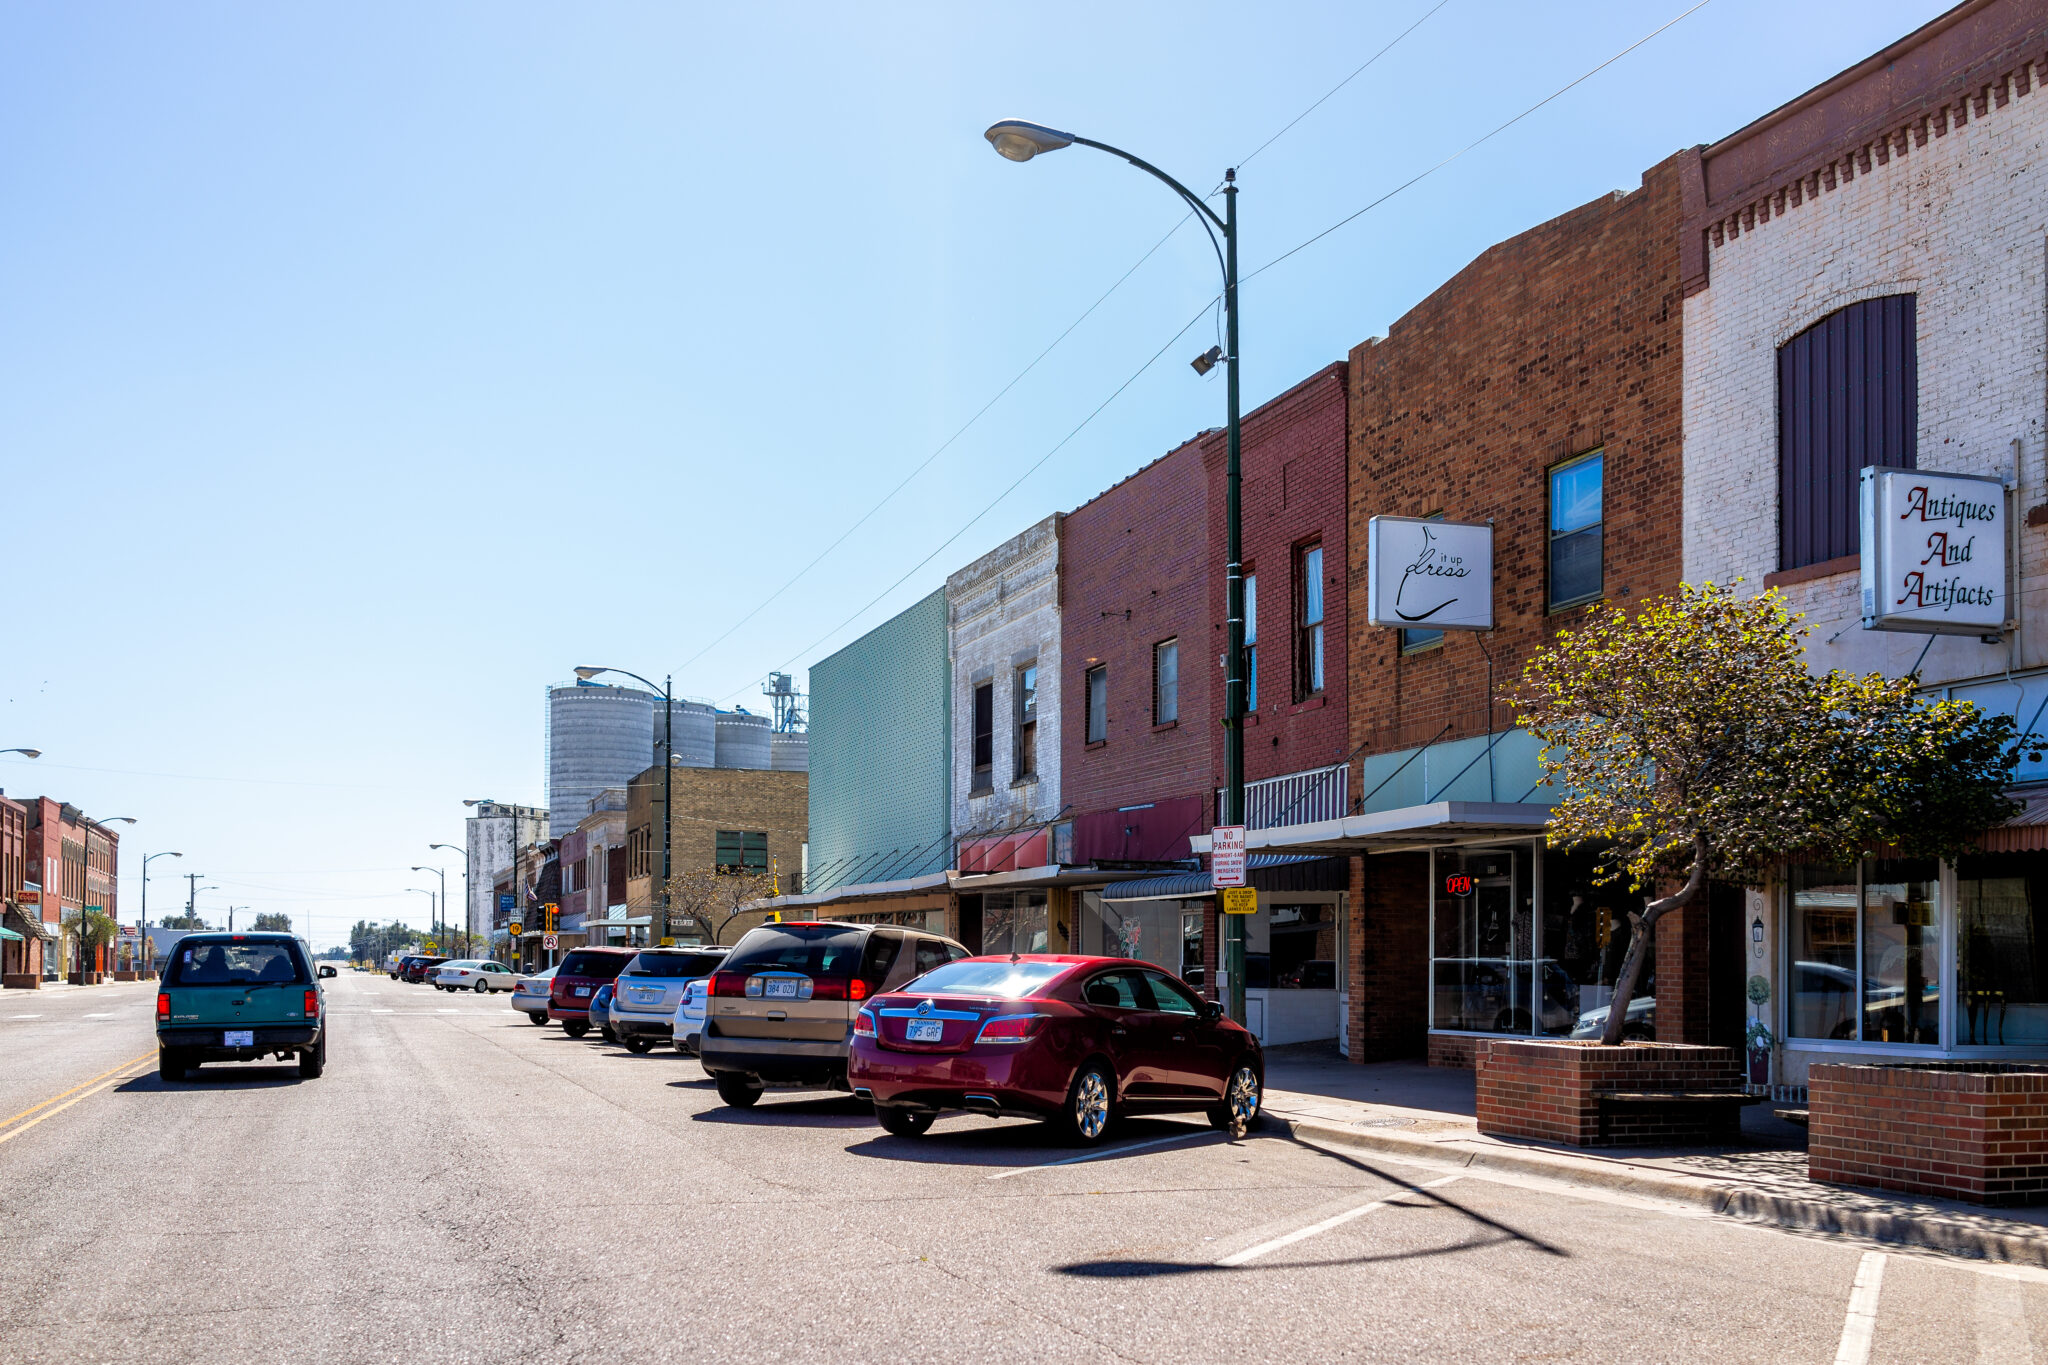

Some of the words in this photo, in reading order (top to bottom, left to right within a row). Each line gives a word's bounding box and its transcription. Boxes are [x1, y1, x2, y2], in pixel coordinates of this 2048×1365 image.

[1900, 486, 1996, 528] Antiques
[1920, 531, 1975, 567] And
[1406, 548, 1471, 577] dress
[1440, 553, 1447, 563] it
[1451, 556, 1463, 566] up
[1897, 571, 1993, 611] Artifacts
[1223, 831, 1233, 840] NO
[1213, 841, 1244, 850] PARKING
[1447, 876, 1471, 893] OPEN
[767, 984, 780, 993] 384
[909, 1026, 923, 1037] 795
[926, 1026, 941, 1037] GRF
